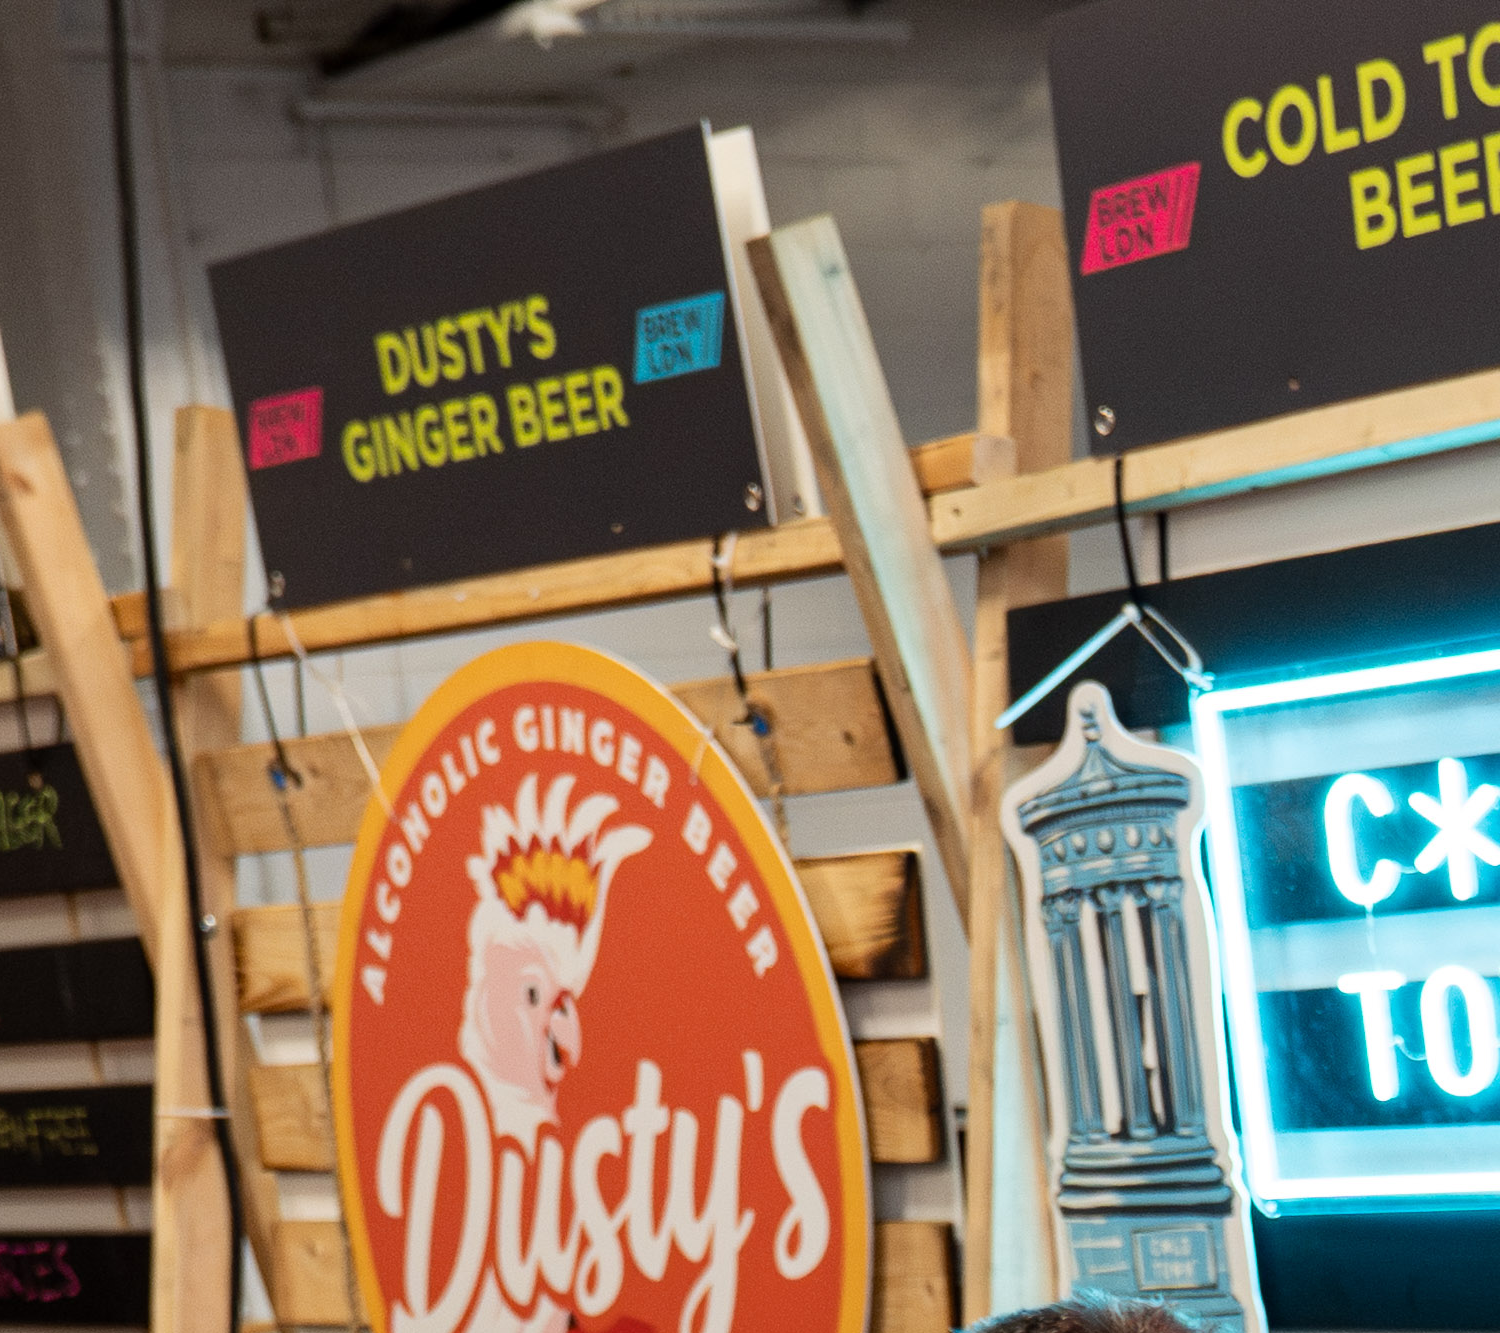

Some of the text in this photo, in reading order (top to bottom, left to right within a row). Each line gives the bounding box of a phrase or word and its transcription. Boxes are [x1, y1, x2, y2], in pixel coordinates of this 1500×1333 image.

[1221, 58, 1407, 180] COLD
[1100, 181, 1171, 229] BREW
[1101, 222, 1156, 263] LDN
[372, 293, 558, 396] DUSTY'S
[340, 363, 630, 484] GINGER BEER
[359, 703, 780, 1007] ALCOHOLIC GINGER BEER
